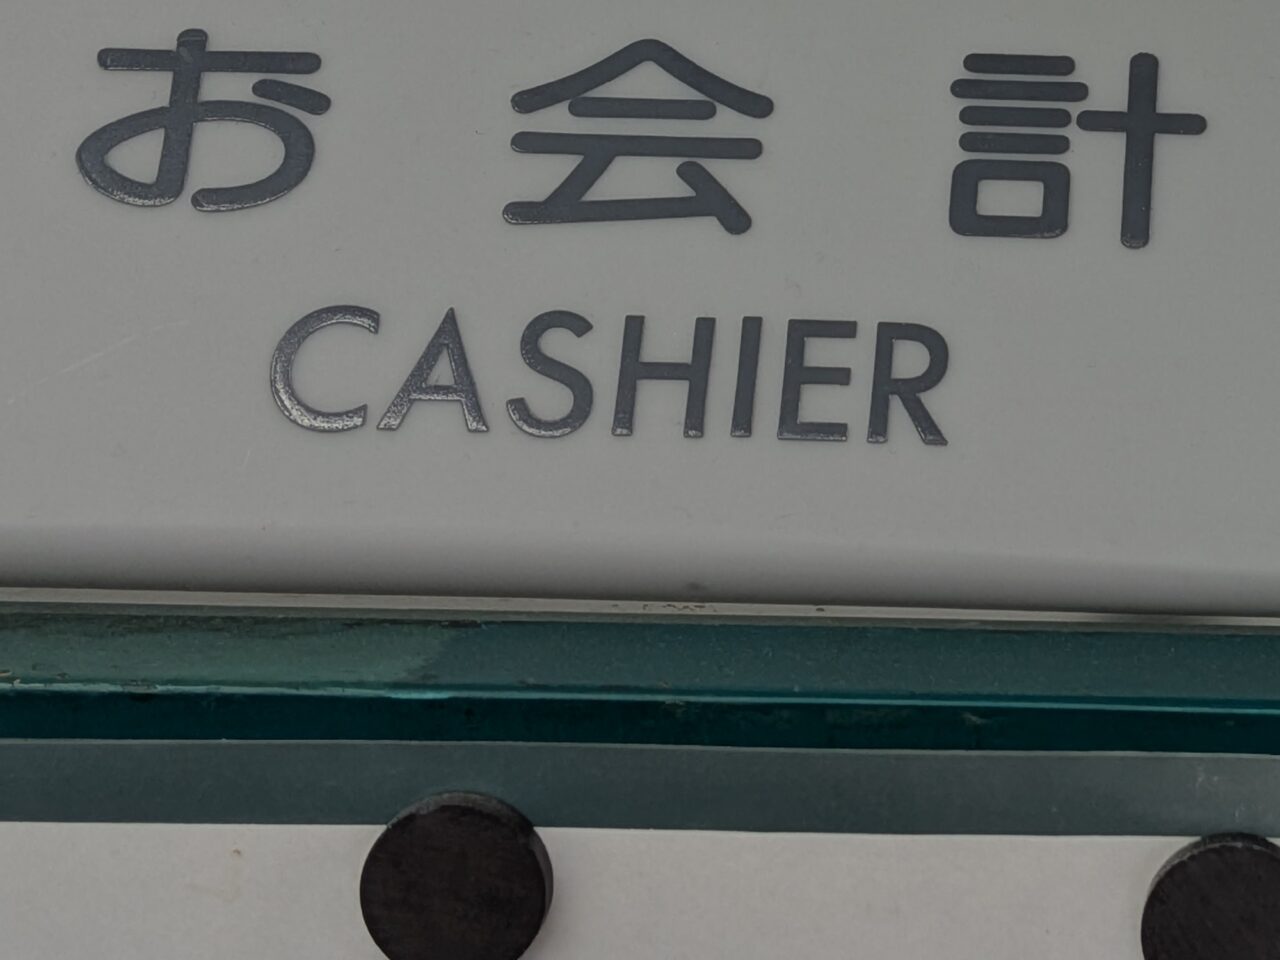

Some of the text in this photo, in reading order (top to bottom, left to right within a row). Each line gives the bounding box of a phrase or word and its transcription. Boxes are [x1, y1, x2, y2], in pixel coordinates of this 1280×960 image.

[76, 28, 1208, 249] お会計
[270, 304, 949, 446] CASHIER
